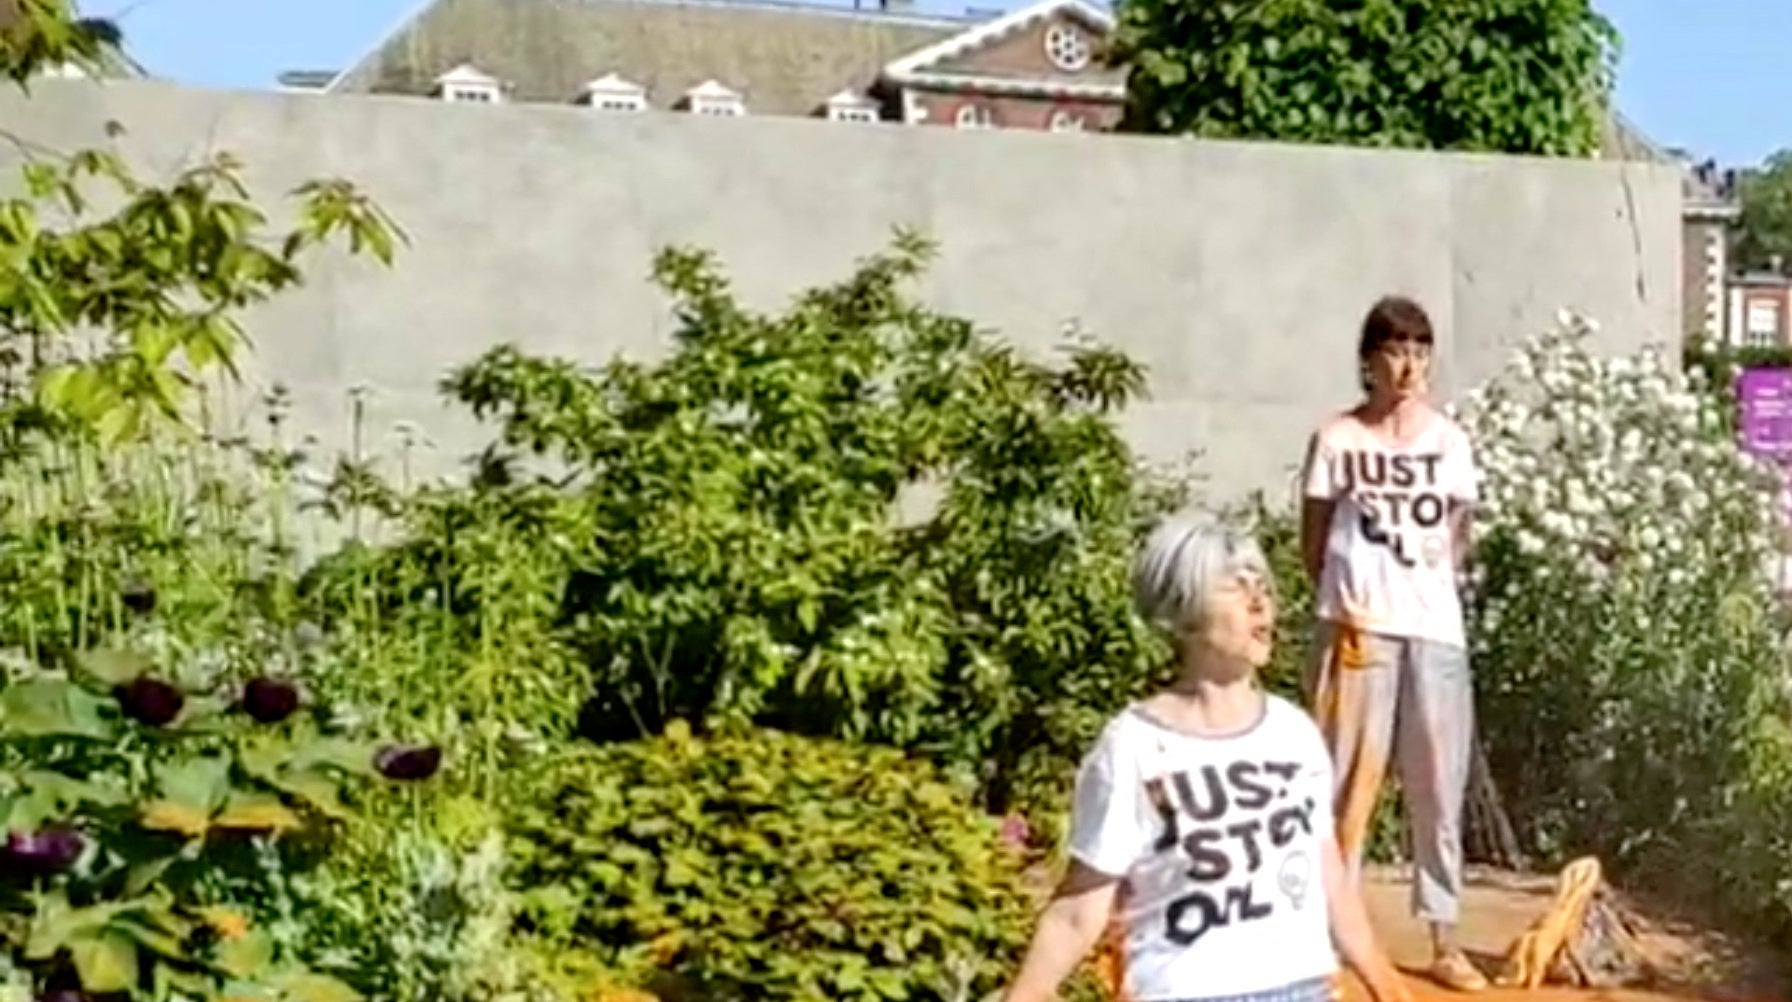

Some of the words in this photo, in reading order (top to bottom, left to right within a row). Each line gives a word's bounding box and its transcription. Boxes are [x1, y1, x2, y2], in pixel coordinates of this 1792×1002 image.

[1335, 449, 1444, 497] JUST
[1357, 491, 1444, 529] STO
[1144, 759, 1303, 854] JUST
